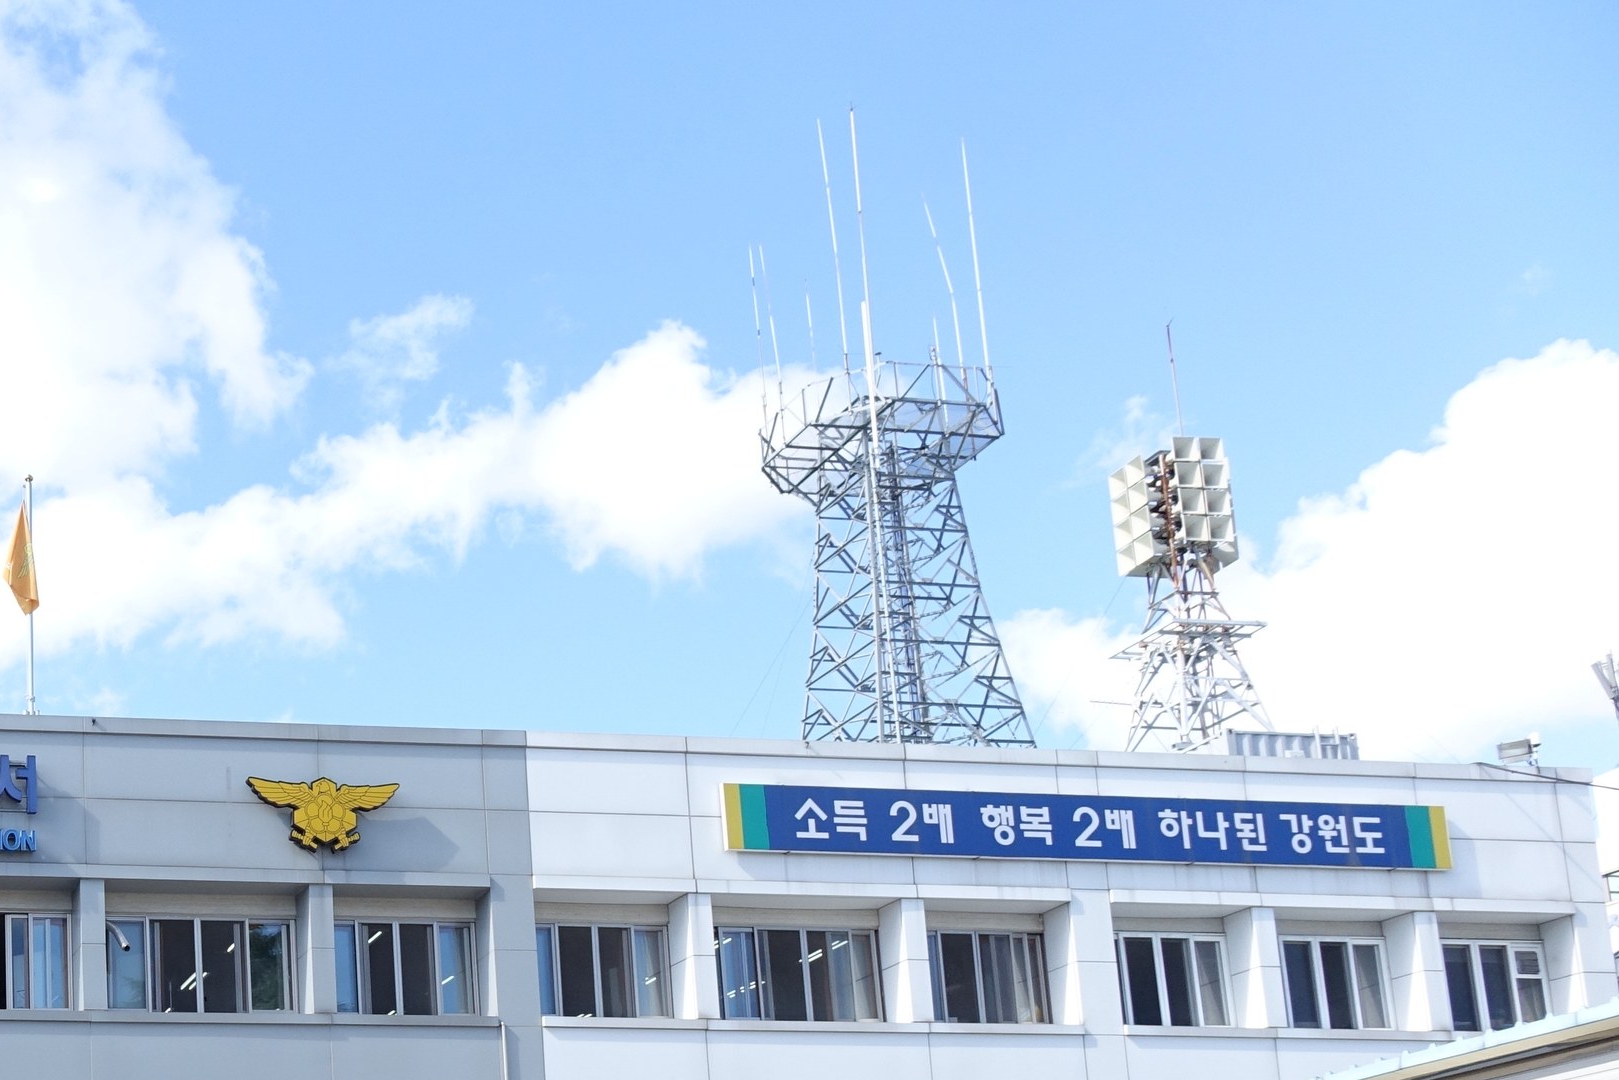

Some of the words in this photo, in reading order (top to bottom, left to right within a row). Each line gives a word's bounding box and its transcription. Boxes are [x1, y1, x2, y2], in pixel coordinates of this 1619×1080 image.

[793, 797, 868, 842] 소득
[891, 800, 955, 844] 2배
[980, 804, 1054, 846] 행복
[1073, 806, 1137, 850] 2배
[1159, 808, 1267, 852] 하나된
[1279, 812, 1386, 856] 강원도
